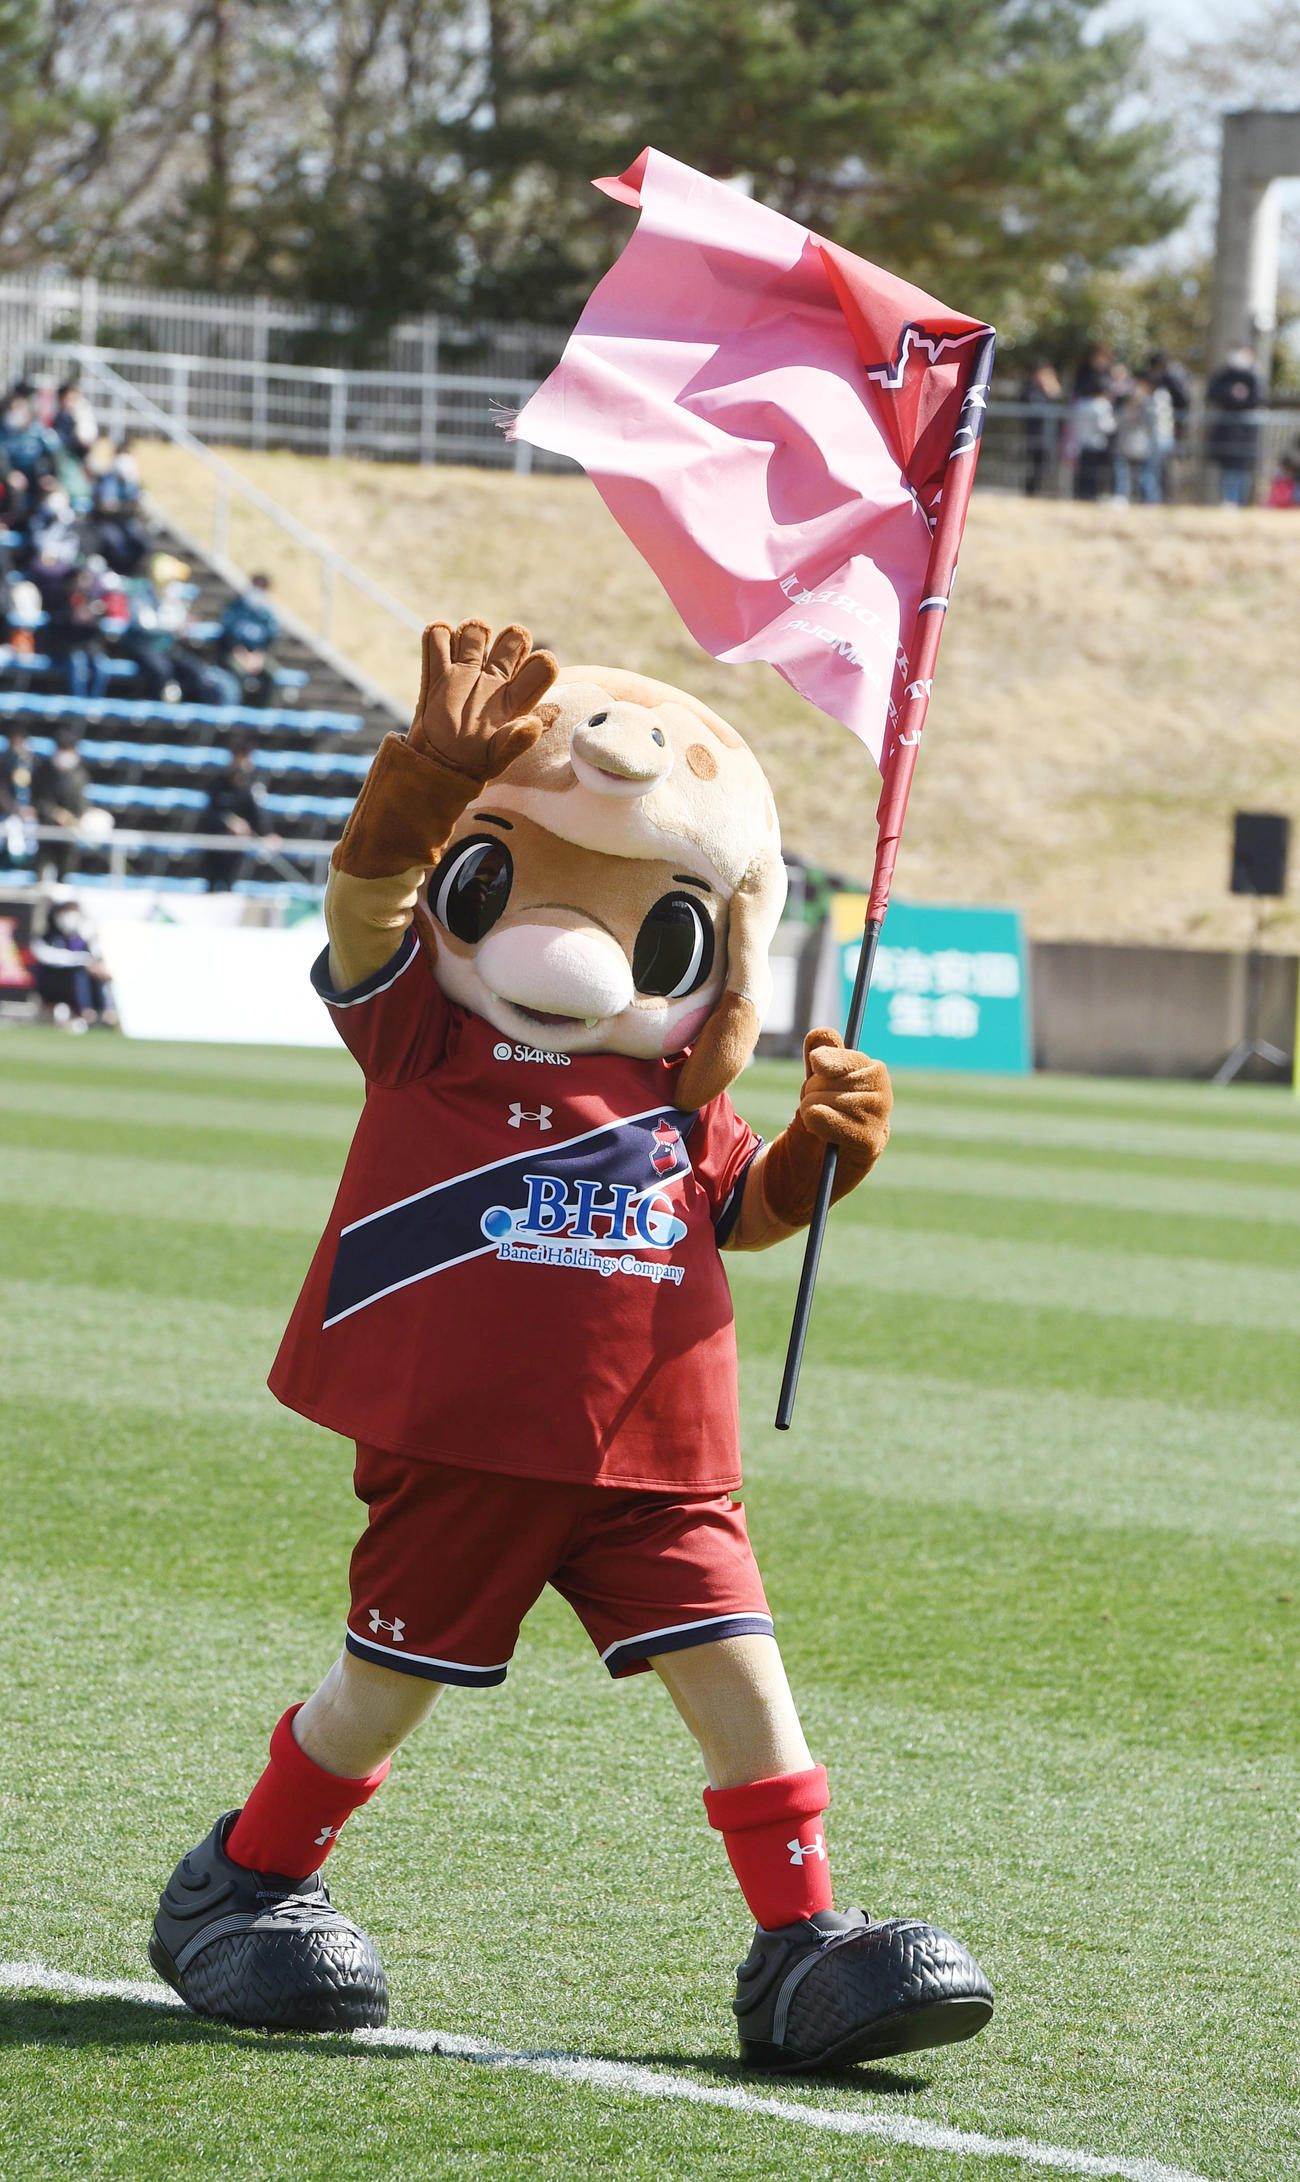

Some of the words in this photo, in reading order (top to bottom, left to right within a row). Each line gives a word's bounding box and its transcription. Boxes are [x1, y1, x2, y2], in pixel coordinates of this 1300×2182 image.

[519, 1176, 676, 1247] BHC
[499, 1243, 547, 1262] Banei
[548, 1247, 617, 1275] Holdings
[620, 1256, 685, 1284] Company
